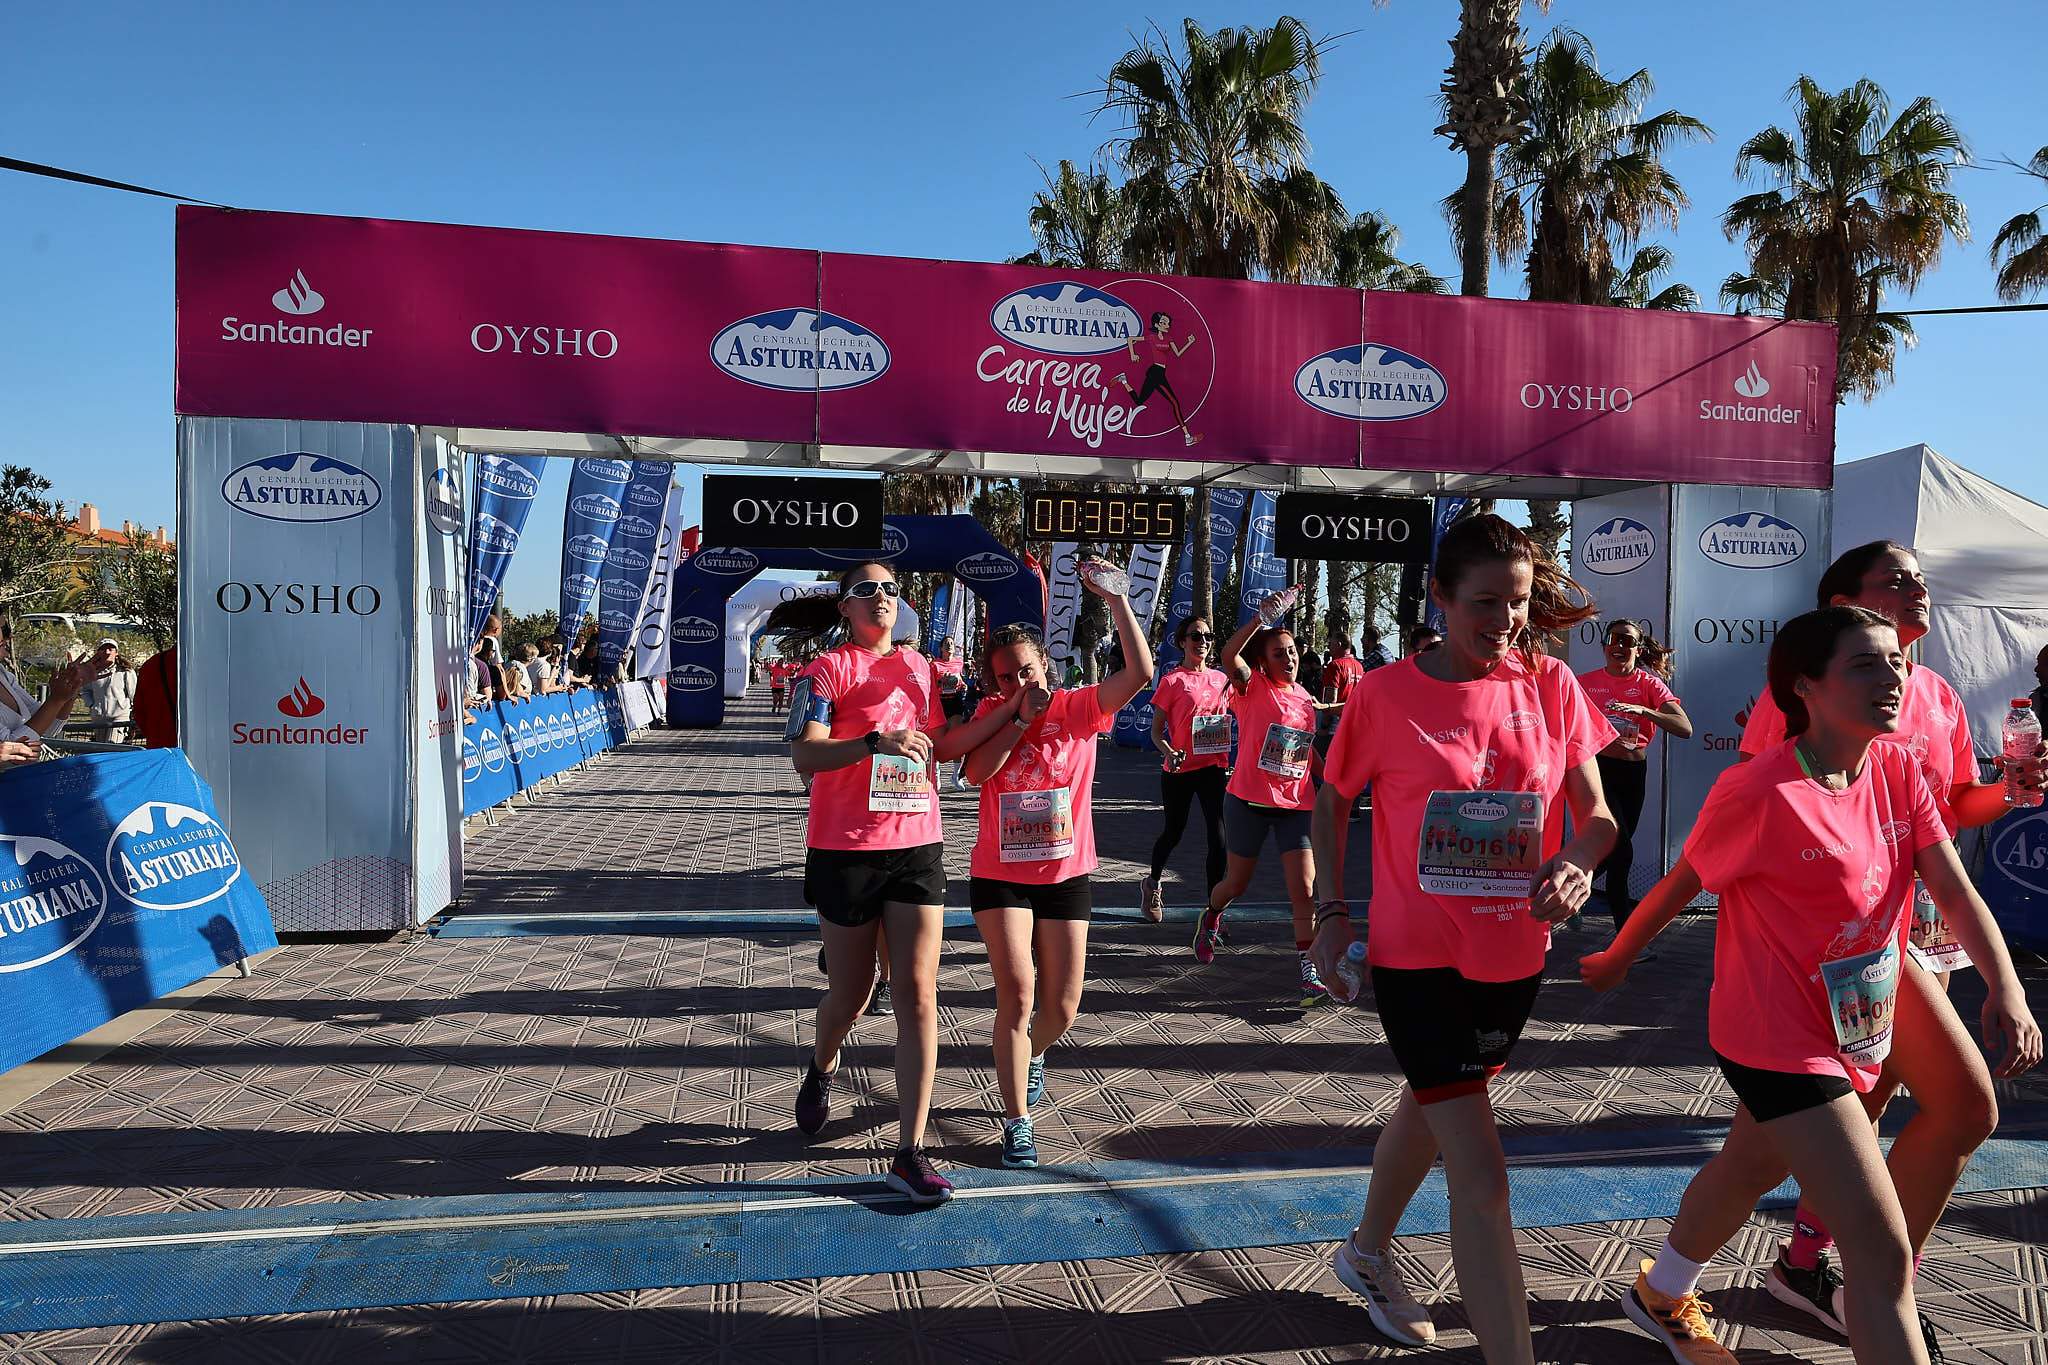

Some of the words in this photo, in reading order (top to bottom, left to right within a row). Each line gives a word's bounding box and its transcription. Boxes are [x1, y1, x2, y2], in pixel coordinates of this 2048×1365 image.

[1002, 304, 1130, 339] ASTURIANA
[1026, 304, 1075, 315] CENTRAL
[1079, 308, 1127, 318] LECHERA
[222, 317, 373, 347] Santander
[471, 323, 619, 359] OYSHO
[753, 335, 809, 345] CENTRAL
[725, 335, 877, 372] ASTURIANA
[976, 345, 1102, 389] Carrera
[1330, 368, 1378, 378] CENTRAL
[1383, 371, 1432, 381] LECHERA
[1306, 368, 1436, 402] ASTURIANA
[1520, 383, 1634, 413] OYSHO
[1007, 387, 1030, 413] de
[1035, 387, 1051, 414] la
[1048, 386, 1147, 448] Mujer
[1700, 399, 1802, 424] Santander
[234, 476, 370, 506] ASTURIANA
[259, 475, 310, 485] CENTRAL
[315, 477, 365, 486] LECHERA
[733, 498, 859, 528] OYSHO
[1035, 498, 1173, 536] 00:38:55
[1301, 514, 1410, 543] OYSHO
[1586, 541, 1649, 563] ASTURIANA
[1707, 532, 1798, 556] ASTURIANA
[699, 556, 754, 569] ASTURIANA
[961, 562, 1015, 575] ASTURIANA
[216, 582, 382, 617] OYSHO
[426, 585, 461, 617] OYSHO
[671, 624, 716, 638] ASTURIANA
[1694, 618, 1778, 644] OYSH
[669, 672, 714, 686] ASTURIANA
[233, 722, 369, 746] Santander
[1461, 803, 1505, 817] ASTURIANA
[133, 837, 178, 855] CENTRAL
[180, 828, 219, 844] LECHERA
[1459, 836, 1504, 856] 016
[1802, 840, 1854, 860] OYSHO
[27, 863, 79, 886] LECHERA
[120, 841, 235, 894] ASTURIANA
[1425, 866, 1454, 875] CARRERA
[1455, 867, 1464, 875] DE
[1466, 868, 1474, 876] LA
[1431, 880, 1469, 889] OYSHO
[1847, 1039, 1874, 1052] CARRERA
[1852, 1045, 1884, 1063] OYSHO
